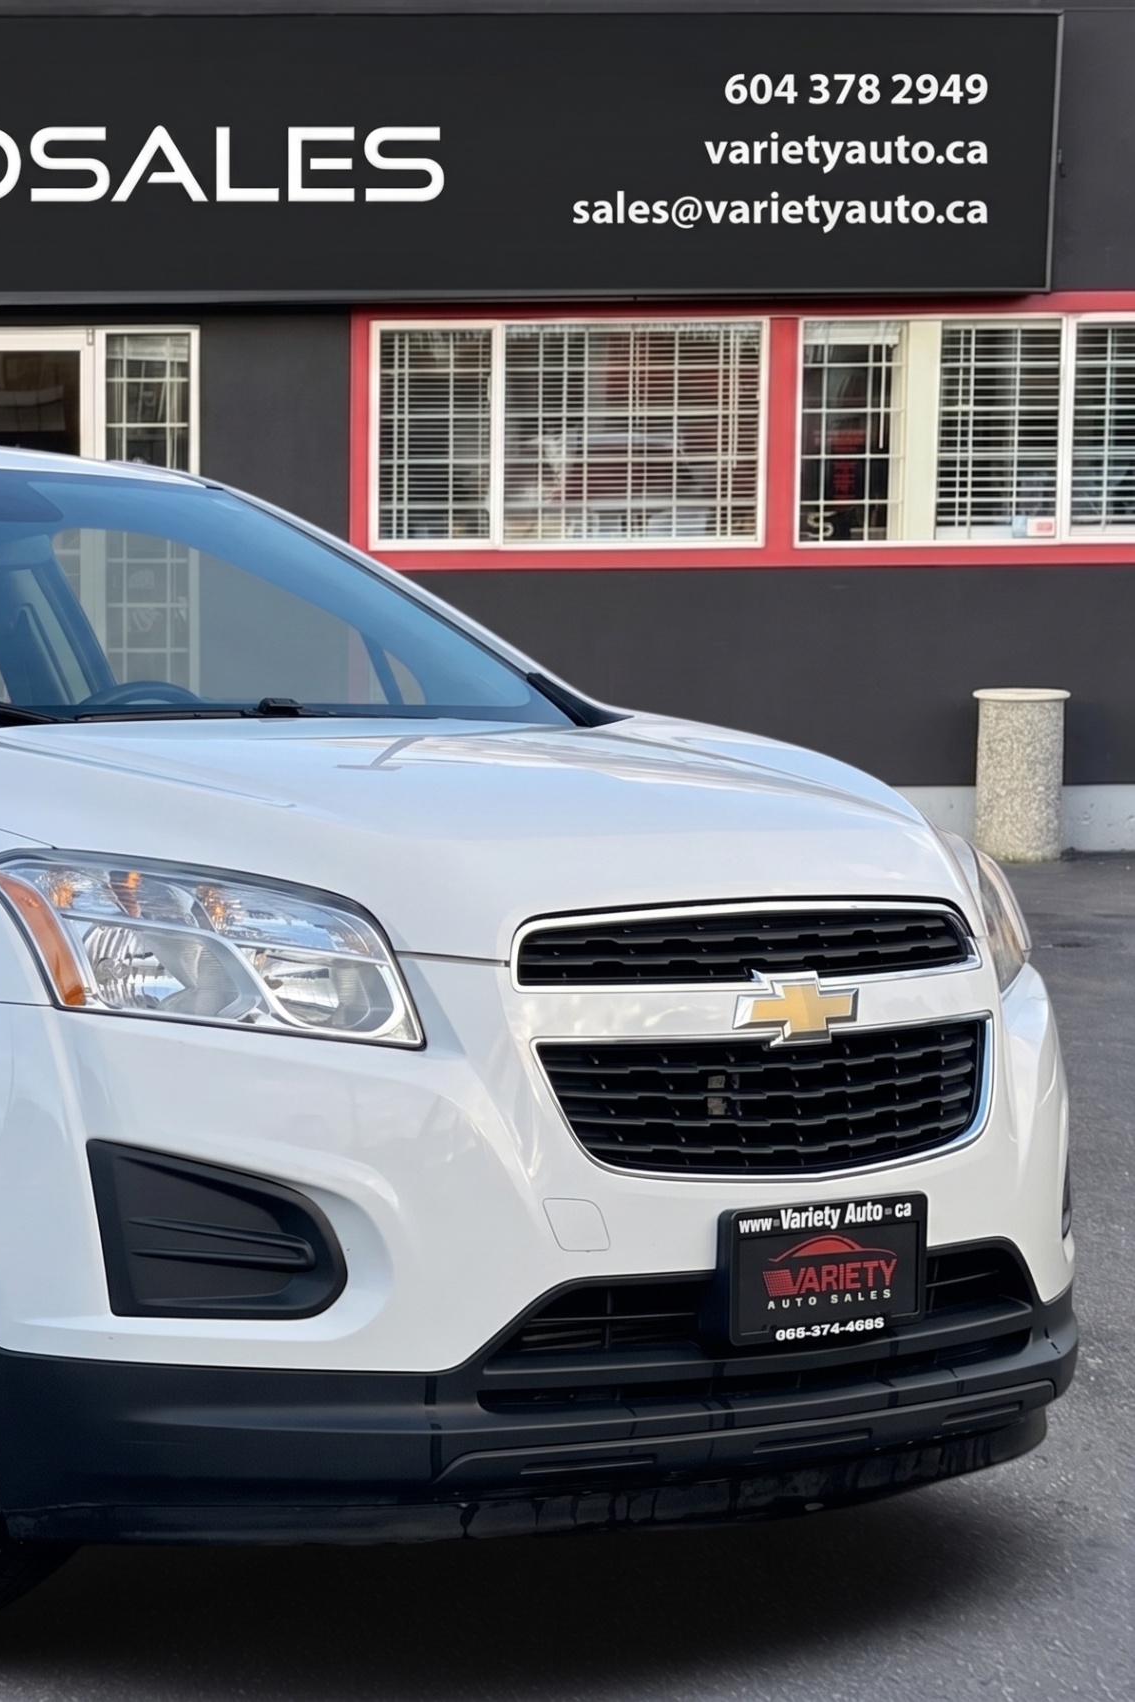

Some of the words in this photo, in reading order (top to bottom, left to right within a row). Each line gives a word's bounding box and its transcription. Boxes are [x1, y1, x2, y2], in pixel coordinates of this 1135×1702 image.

[724, 73, 798, 105] 604
[808, 73, 881, 105] 378
[890, 73, 989, 105] 2949
[704, 131, 989, 174] varietyauto.ca
[572, 190, 989, 234] sales@varietyauto.ca
[780, 1206, 841, 1230] Variety
[844, 1202, 883, 1224] Auto
[763, 1258, 898, 1298] VARIETY
[767, 1297, 817, 1310] AUTO
[830, 1289, 892, 1304] SALES
